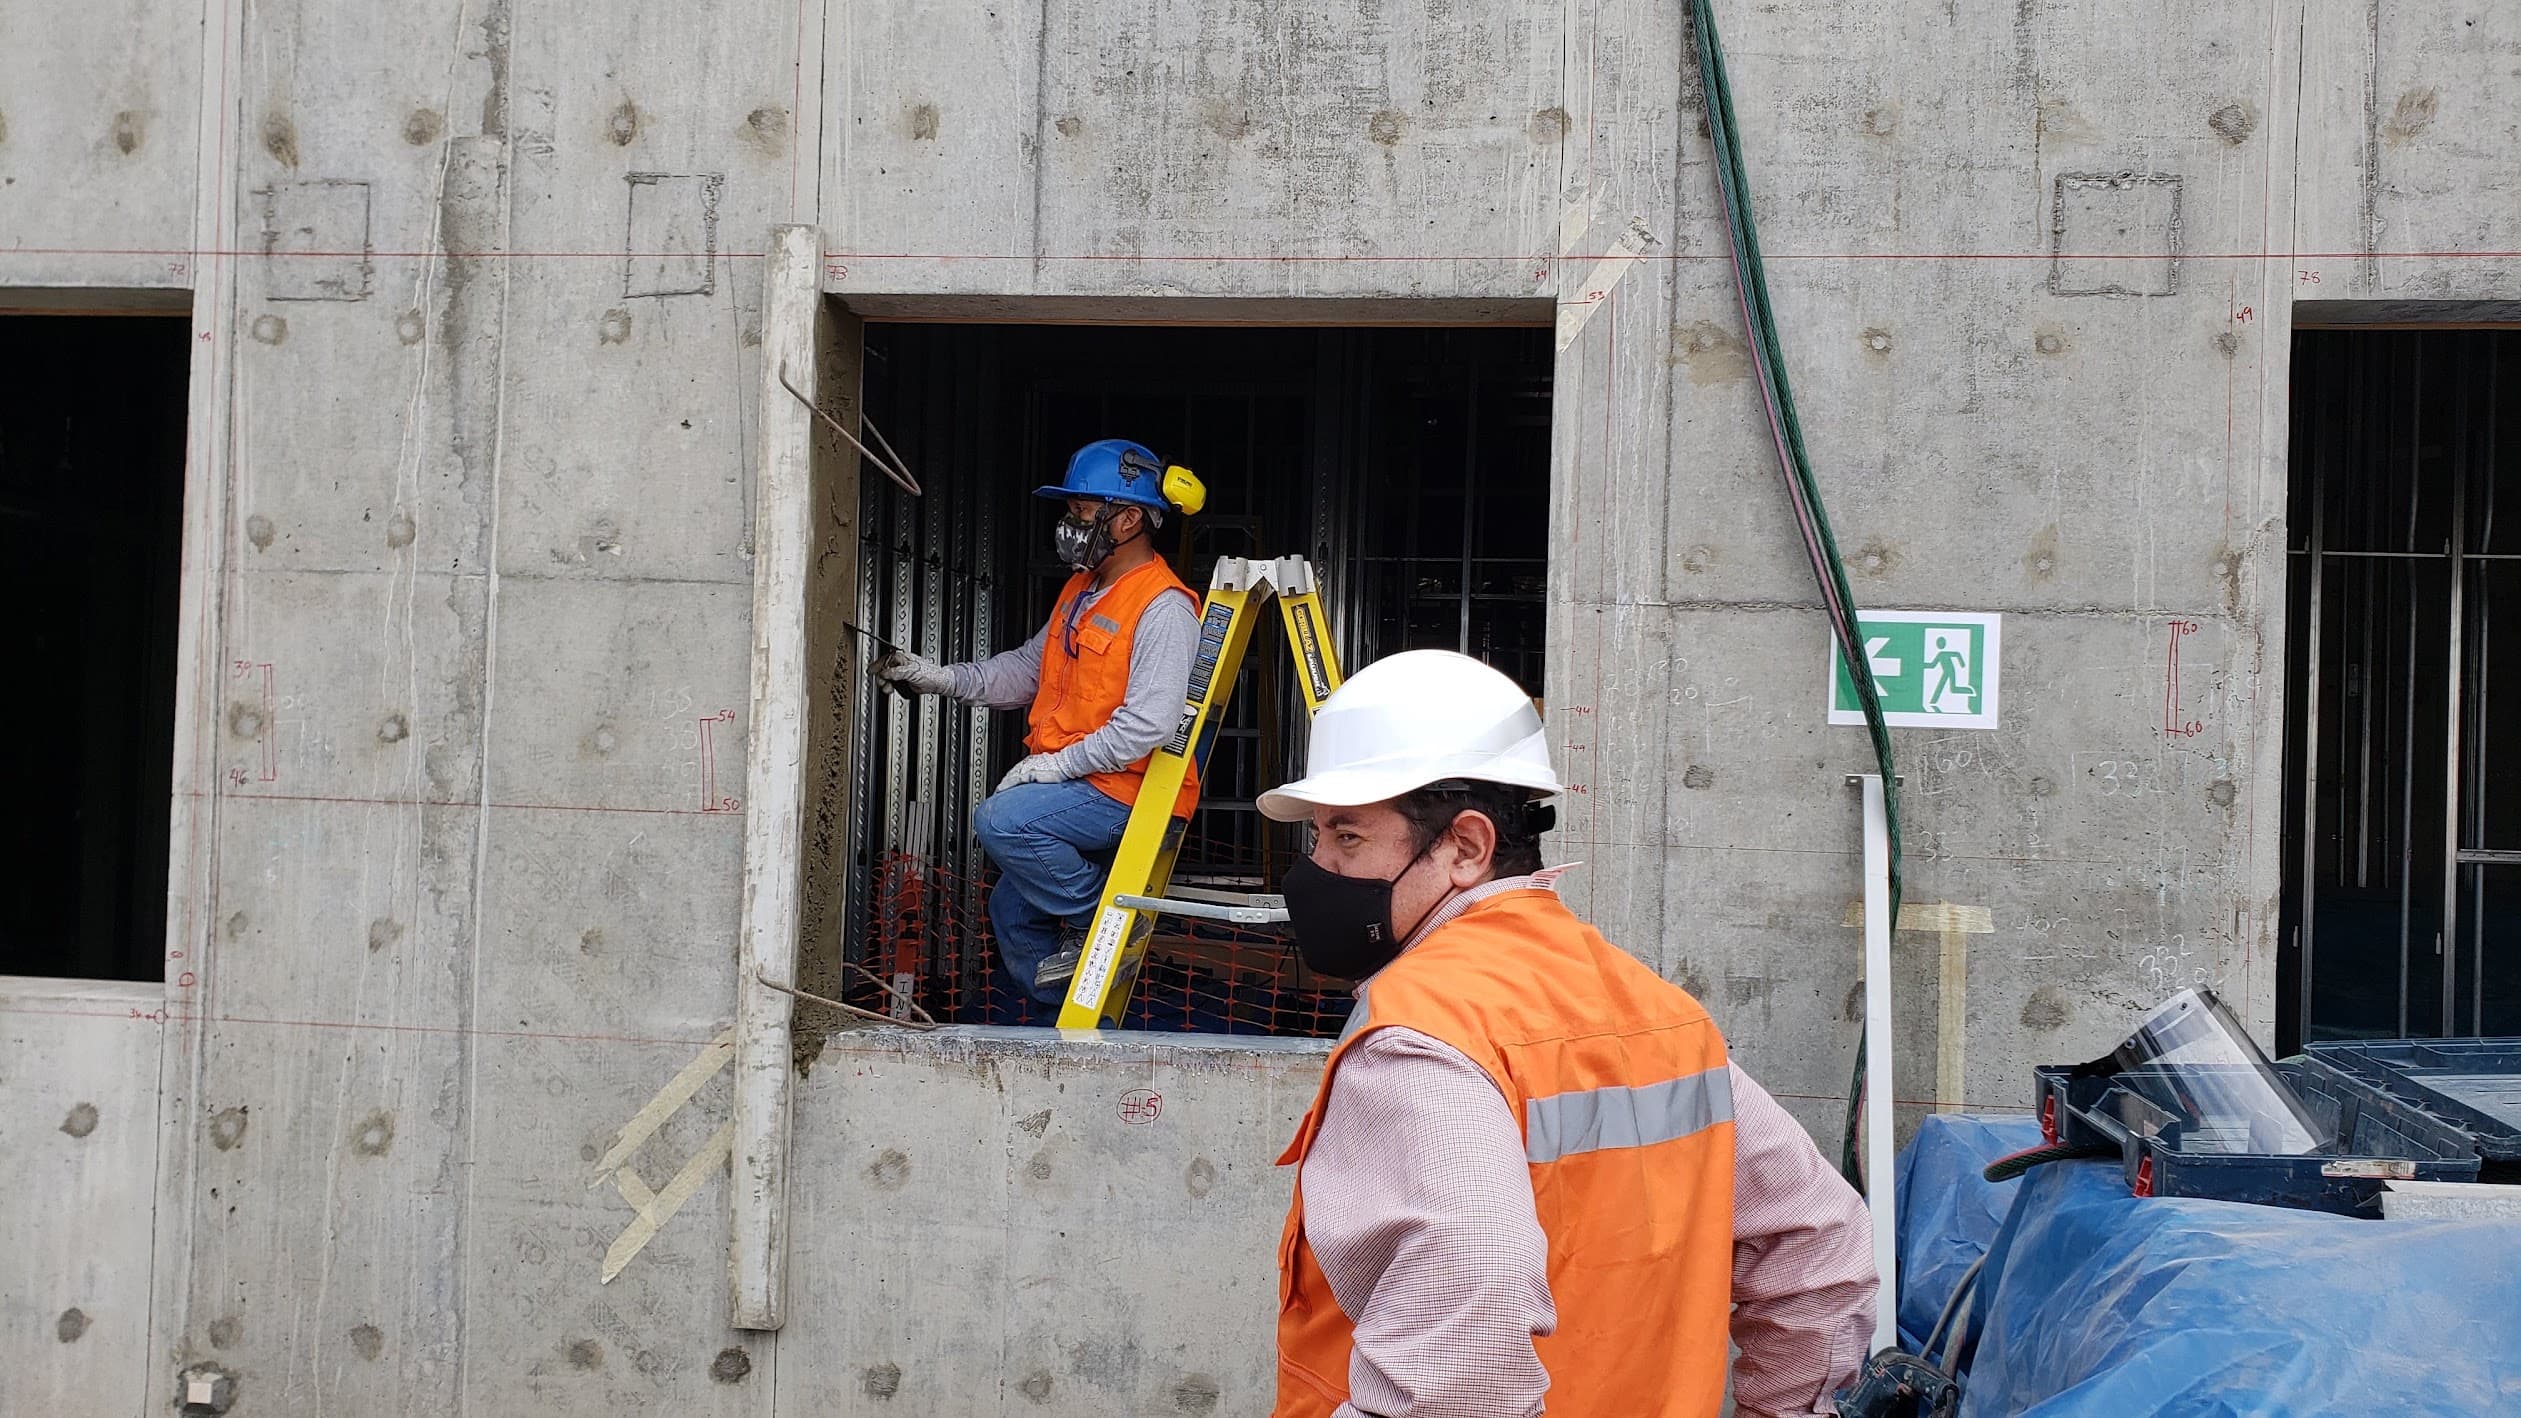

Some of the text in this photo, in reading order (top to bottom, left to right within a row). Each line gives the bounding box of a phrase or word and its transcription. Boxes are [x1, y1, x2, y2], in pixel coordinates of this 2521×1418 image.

[2298, 270, 2320, 285] 78
[2236, 306, 2252, 323] 49
[2182, 620, 2198, 635] 60
[718, 709, 735, 726] 54
[2185, 720, 2203, 738] 60
[229, 768, 248, 788] 46
[1571, 784, 1588, 795] 46
[722, 797, 740, 812] 50
